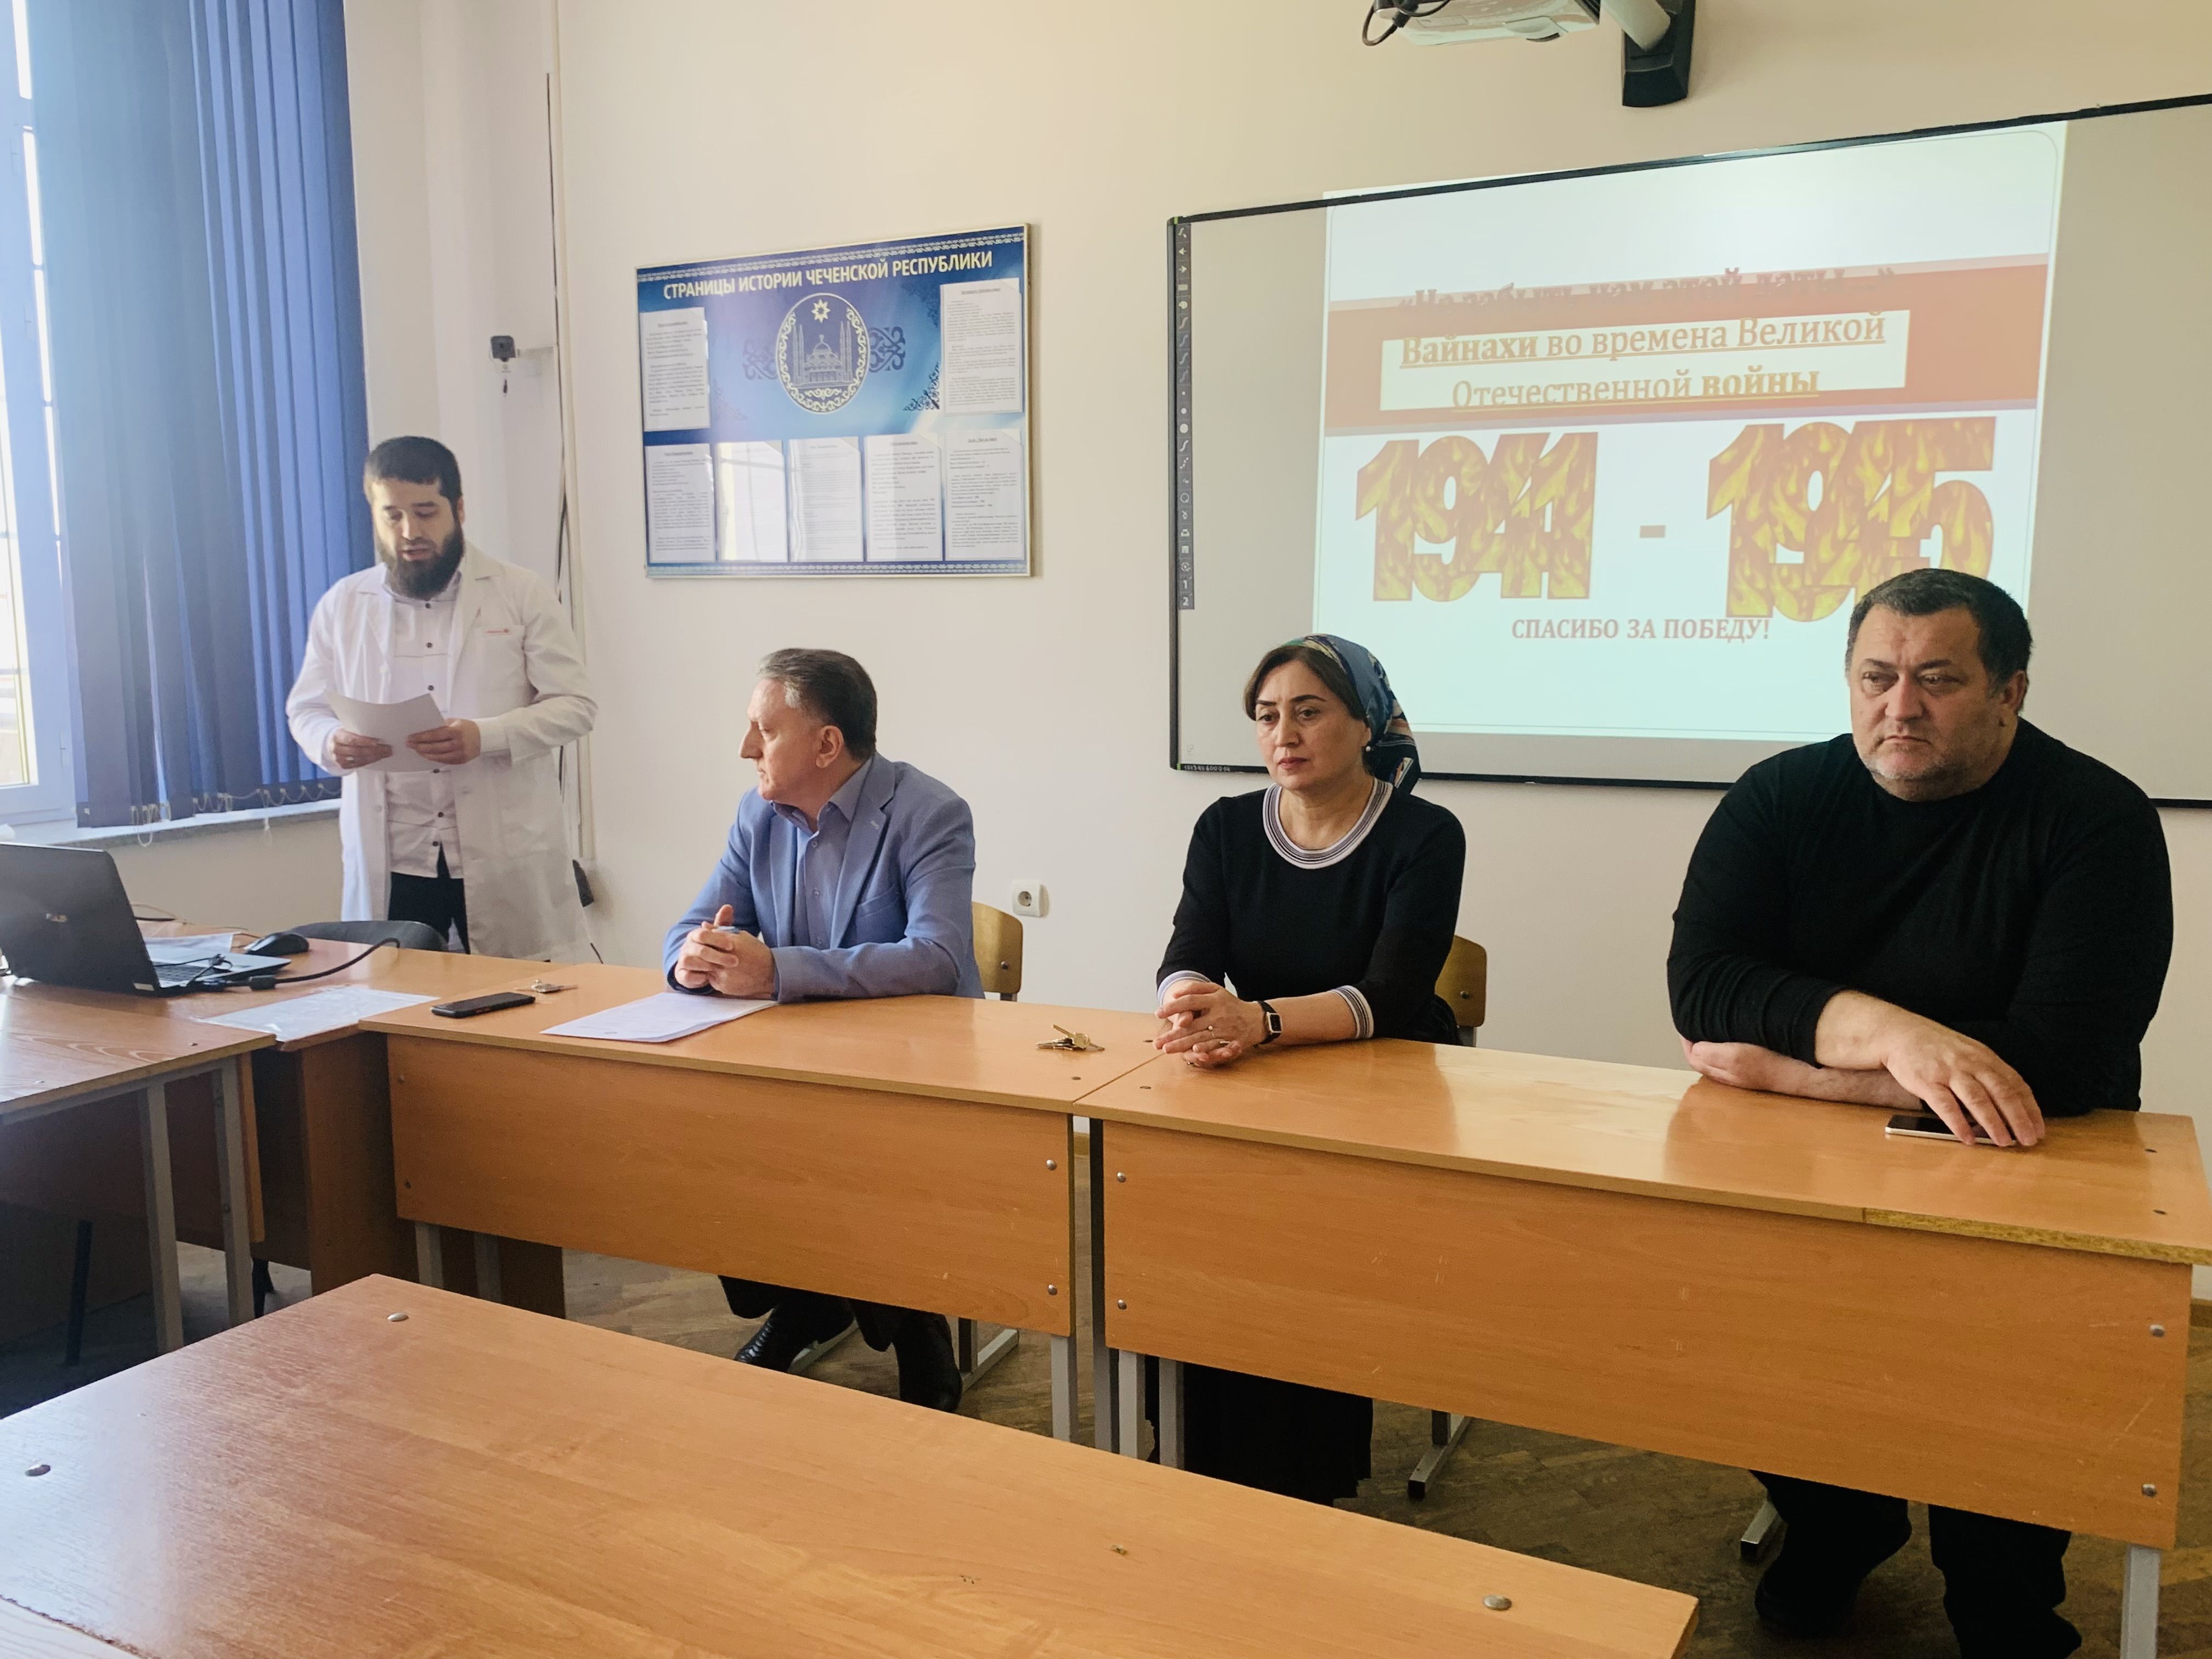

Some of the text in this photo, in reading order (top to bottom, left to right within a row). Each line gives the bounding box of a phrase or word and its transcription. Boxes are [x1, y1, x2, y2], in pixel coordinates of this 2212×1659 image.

[663, 251, 993, 300] СТРАНИЦЫ ИСТОРИИ ЧЕЧЕНСКОЙ РЕСПУБЛИКИ
[1401, 311, 1886, 365] Вайнахи во времена Великой
[1451, 364, 1820, 408] Отечественной войны
[1355, 431, 1599, 602] 1941
[1706, 416, 1997, 623] 1945
[1511, 618, 1770, 644] СПАСИБО ЗА ПОБЕДУ!
